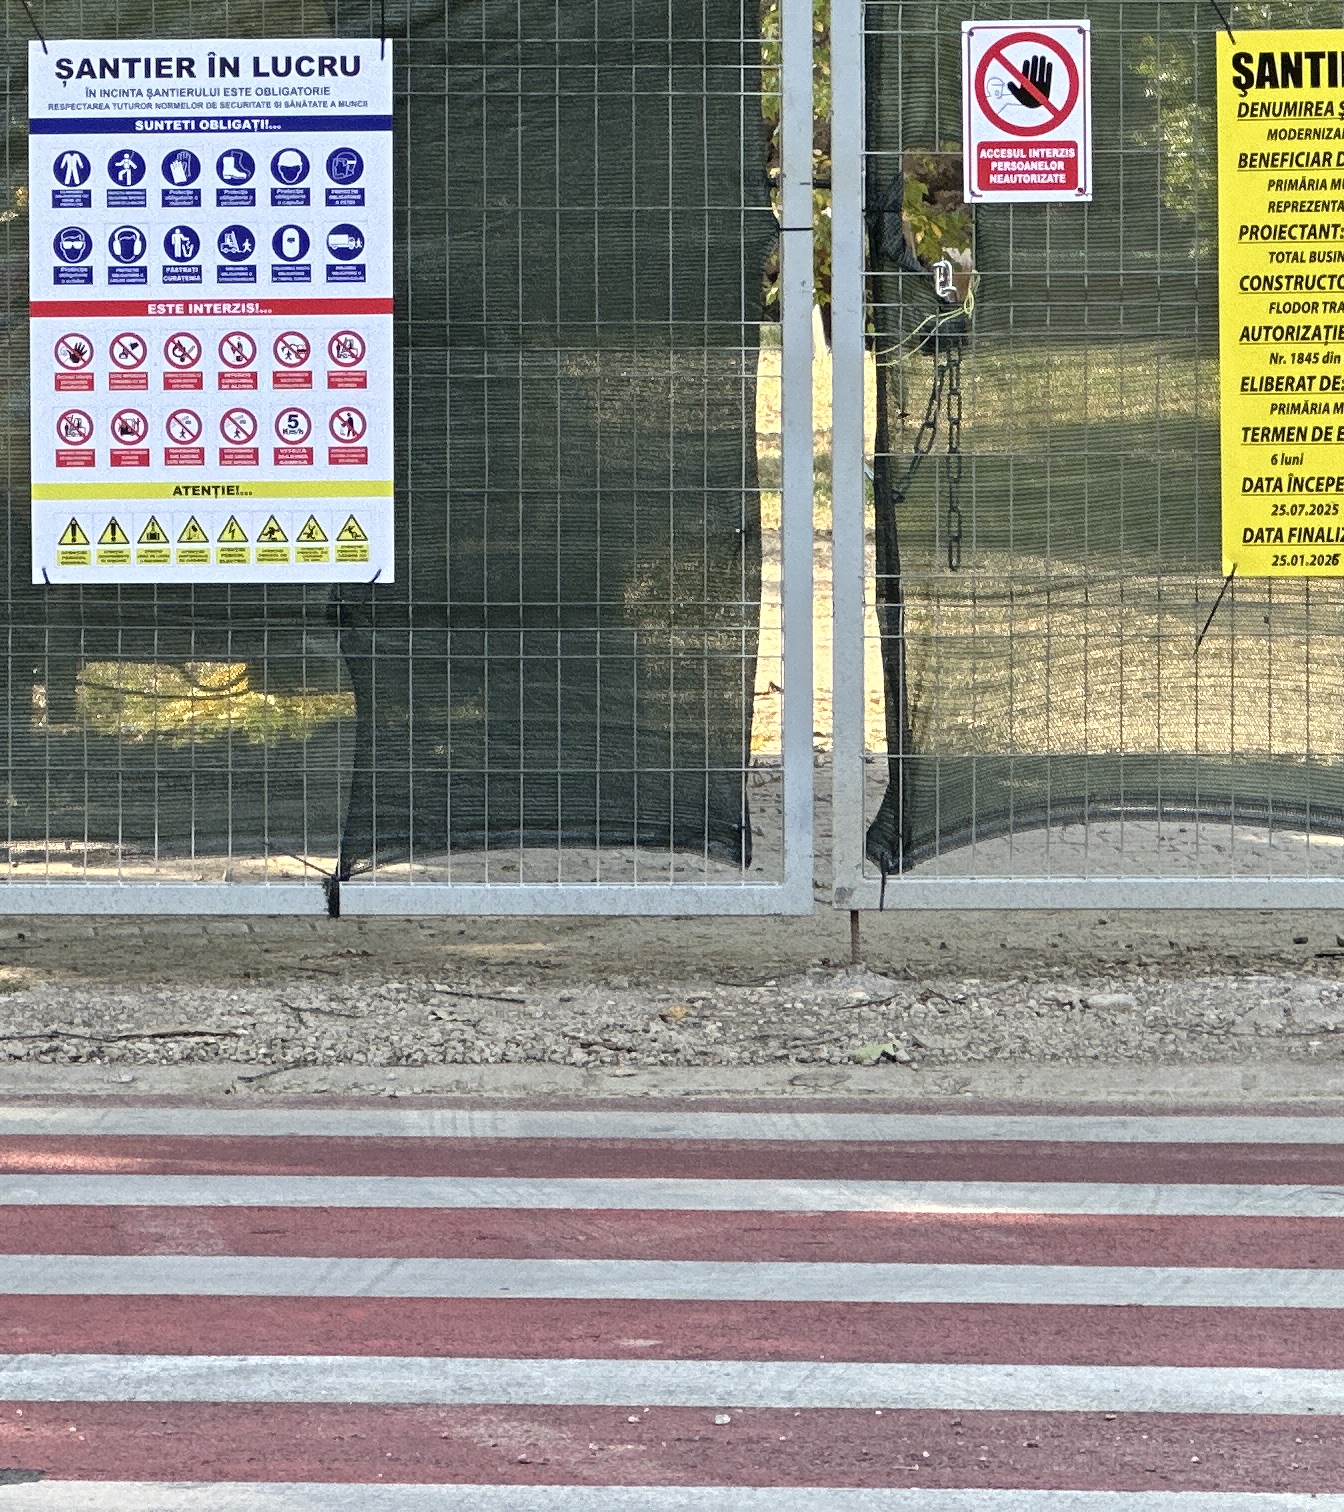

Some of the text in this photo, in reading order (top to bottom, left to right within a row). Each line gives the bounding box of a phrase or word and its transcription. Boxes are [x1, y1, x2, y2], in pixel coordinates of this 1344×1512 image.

[207, 52, 244, 78] ÎN
[253, 55, 361, 78] LUCRU
[86, 86, 96, 98] ÎN
[100, 87, 143, 98] INCINTA
[224, 86, 253, 97] ESTE
[256, 86, 330, 97] OBLIGATORIE
[1238, 101, 1333, 118] DENUMIREA
[135, 120, 195, 130] SUNTETI
[980, 148, 1075, 158] ACCESUL INTERZIS
[1238, 152, 1332, 168] BENEFICIAR
[991, 161, 1064, 171] PERSOANELOR
[990, 173, 1066, 183] NEAUTORIZATE
[1268, 175, 1327, 191] PRIMĂRIA
[1239, 224, 1344, 241] PROIECTANT:
[1269, 251, 1306, 264] TOTAL
[148, 304, 184, 314] ESTE
[1269, 301, 1319, 314] FLODOR
[1269, 352, 1286, 365] Nr.
[1290, 352, 1319, 364] 1845
[1322, 351, 1341, 364] din
[1240, 376, 1315, 392] ELIBERAT
[1270, 400, 1330, 415] PRIMĂRIA
[288, 414, 299, 428] 5
[1242, 427, 1308, 443] TERMEN
[1312, 426, 1333, 442] DE
[1271, 453, 1303, 466] 6 luni
[1242, 477, 1283, 493] DATA
[1271, 504, 1339, 516] 25.07.2025
[1243, 527, 1285, 543] DATA
[1272, 554, 1341, 566] 25.01.2026
